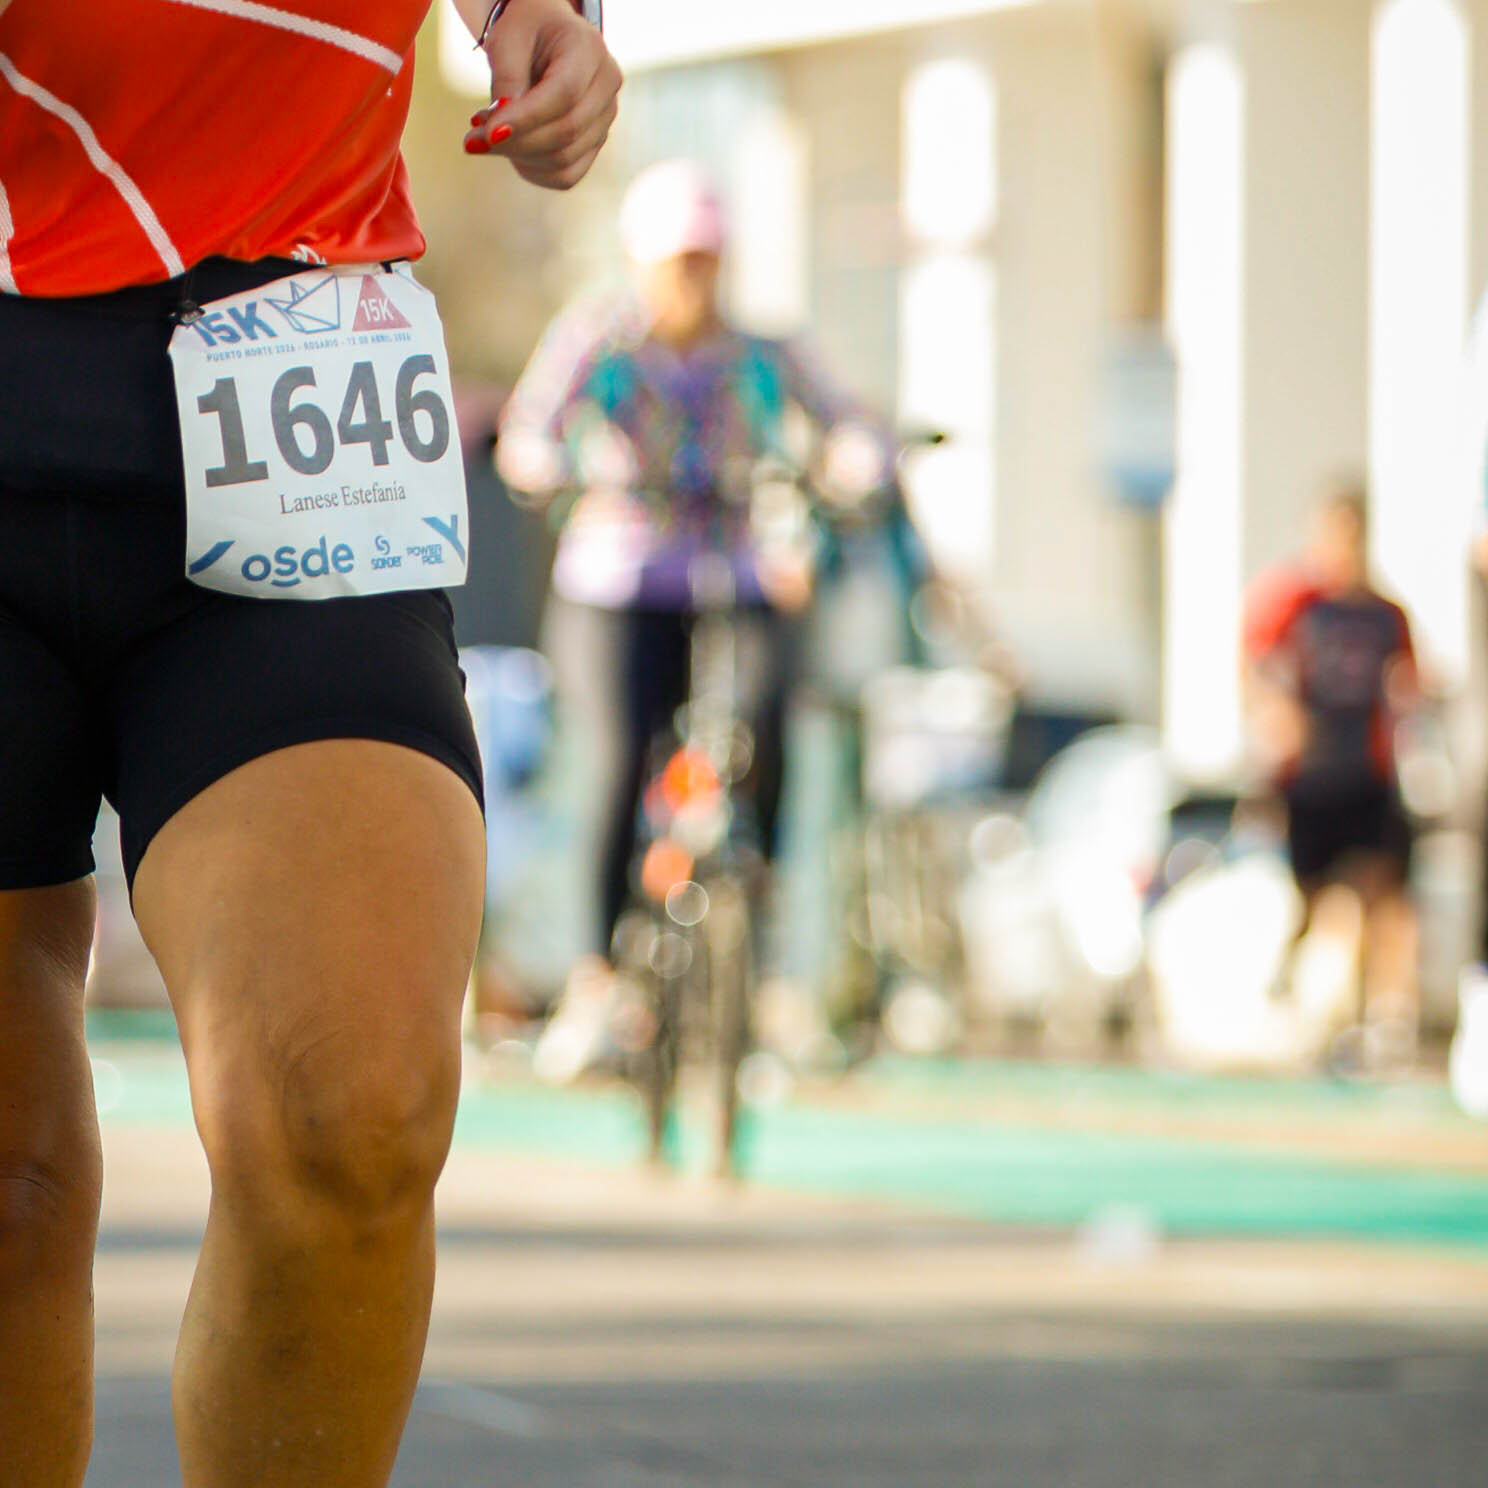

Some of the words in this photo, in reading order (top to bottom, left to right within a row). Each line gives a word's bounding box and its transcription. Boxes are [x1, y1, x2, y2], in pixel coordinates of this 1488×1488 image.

[190, 300, 279, 347] 15K
[360, 297, 394, 323] 15K
[196, 353, 451, 489] 1646
[279, 492, 339, 515] Lanese
[240, 535, 355, 584] osde
